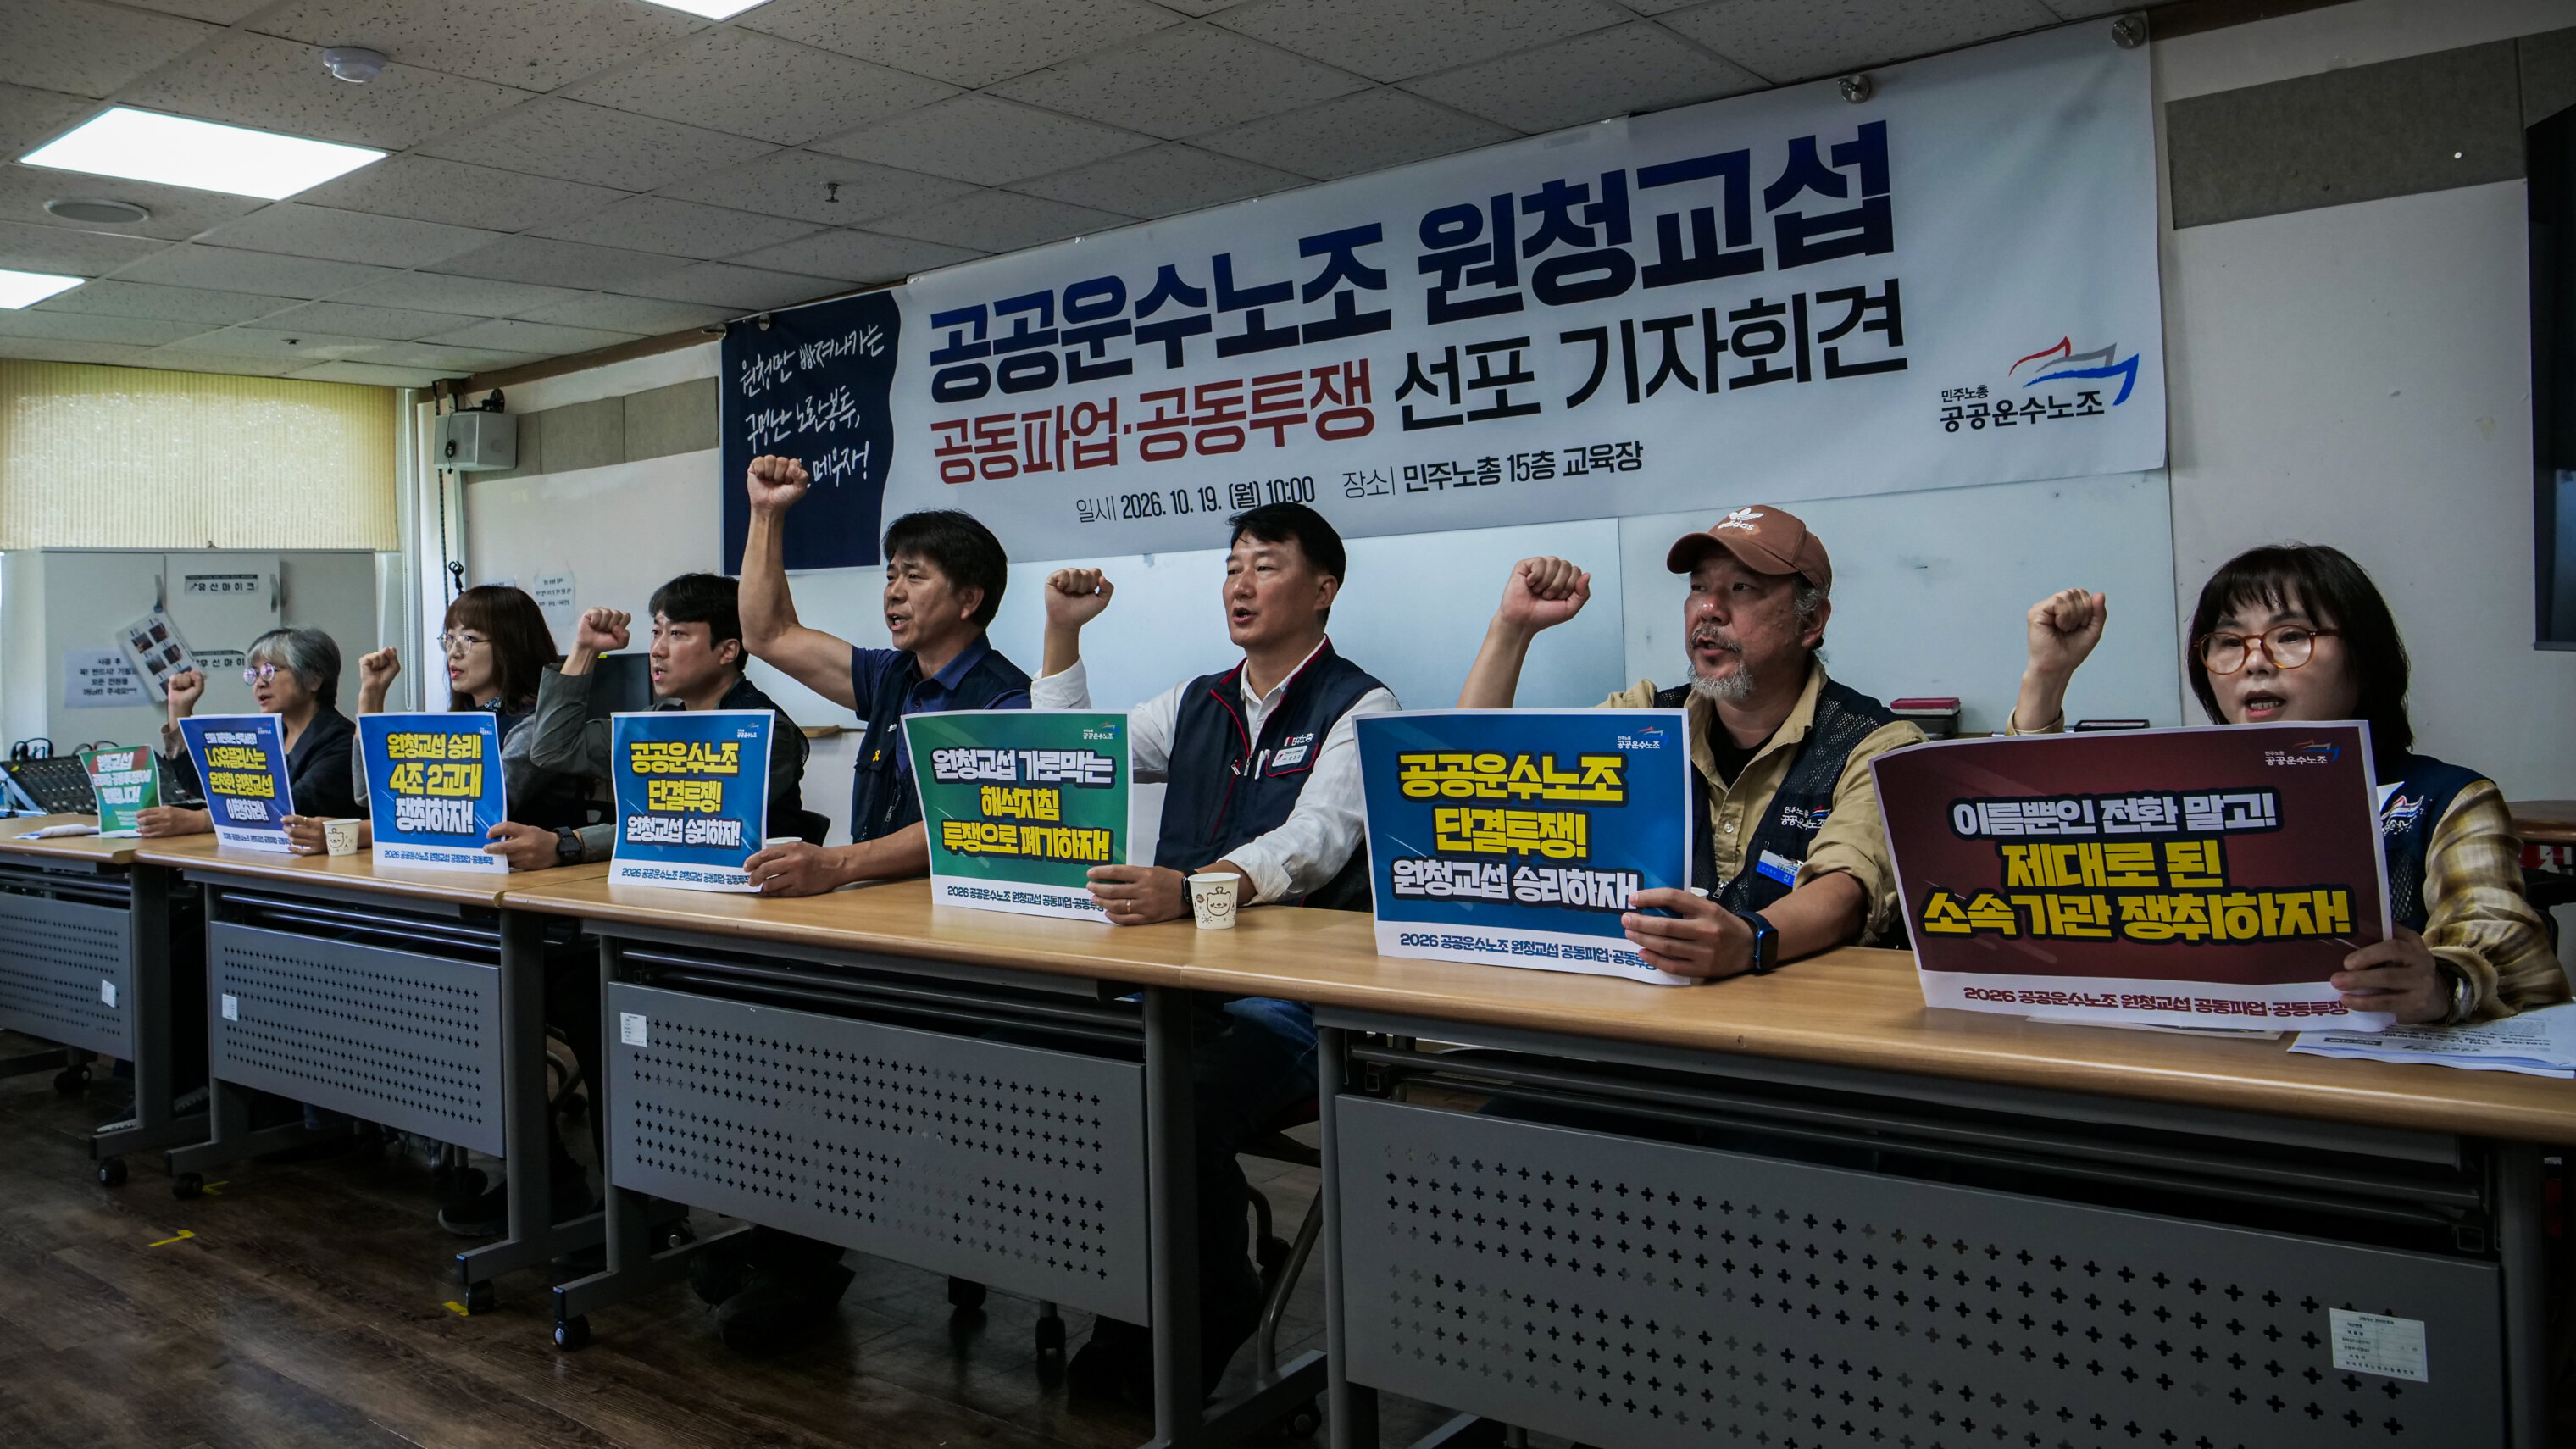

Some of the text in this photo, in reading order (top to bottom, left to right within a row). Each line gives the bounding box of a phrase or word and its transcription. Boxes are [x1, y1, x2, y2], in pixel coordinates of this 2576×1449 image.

[930, 119, 1895, 404] 공공운수노조 원청교섭
[740, 324, 885, 397] 원청만 빠져나가는
[930, 278, 1908, 484] 공동파업·공동투쟁 선포 기자회견
[1941, 384, 1989, 402] 민주노총
[1940, 390, 2105, 433] 공공운수노조
[746, 408, 793, 454] 구멍난
[813, 440, 870, 488] 메우자!
[1120, 492, 1167, 519] 2026.
[1170, 489, 1194, 514] 10.
[1198, 486, 1222, 511] 19.
[1228, 480, 1262, 508] (월)
[1265, 475, 1315, 503] 10:00
[1403, 455, 1502, 493] 민주노총
[1507, 450, 1556, 482] 15층
[1563, 440, 1644, 477] 교육장
[1718, 520, 1754, 530] adidas
[204, 747, 267, 770] LG유플러스는
[386, 734, 481, 758] 원청교섭 승리!
[630, 742, 739, 774] 공공운수노조
[1617, 741, 1661, 749] 공공운수노조
[2264, 755, 2328, 766] 공공운수노조
[389, 763, 482, 797] 4조 2교대
[932, 747, 1113, 784] 원청교섭 가로막는
[1399, 752, 1623, 802] 공공운수노조
[208, 771, 275, 798] 온전한 원청교섭
[648, 780, 722, 813] 단결투쟁!
[395, 797, 475, 833] 쟁취하자!
[980, 786, 1060, 821] 해석지침
[1953, 792, 2276, 836] 이름뿐인 전환 말고!
[626, 815, 741, 846] 원청교섭 승리하자!
[942, 820, 1109, 861] 투쟁으로 폐기하자!
[1435, 807, 1587, 859] 단결투쟁!
[384, 850, 400, 858] 2026
[2001, 839, 2224, 889] 제대로 된
[621, 867, 641, 877] 2026
[641, 869, 678, 880] 공공운수노조
[679, 871, 702, 883] 원청교섭
[1392, 858, 1638, 911] 원청교섭 승리하자!
[947, 886, 969, 897] 2026
[969, 887, 1011, 902] 공공운수노조
[1012, 891, 1041, 905] 원청교섭
[1924, 890, 2351, 941] 소속기관 쟁취하자!
[1400, 933, 1439, 947] 2026
[1440, 935, 1510, 954] 공공운수노조
[1511, 940, 1559, 958] 원청교섭
[1963, 986, 2016, 1002] 2026
[2018, 990, 2119, 1008] 공공운수노조
[2120, 994, 2192, 1013] 원청교섭
